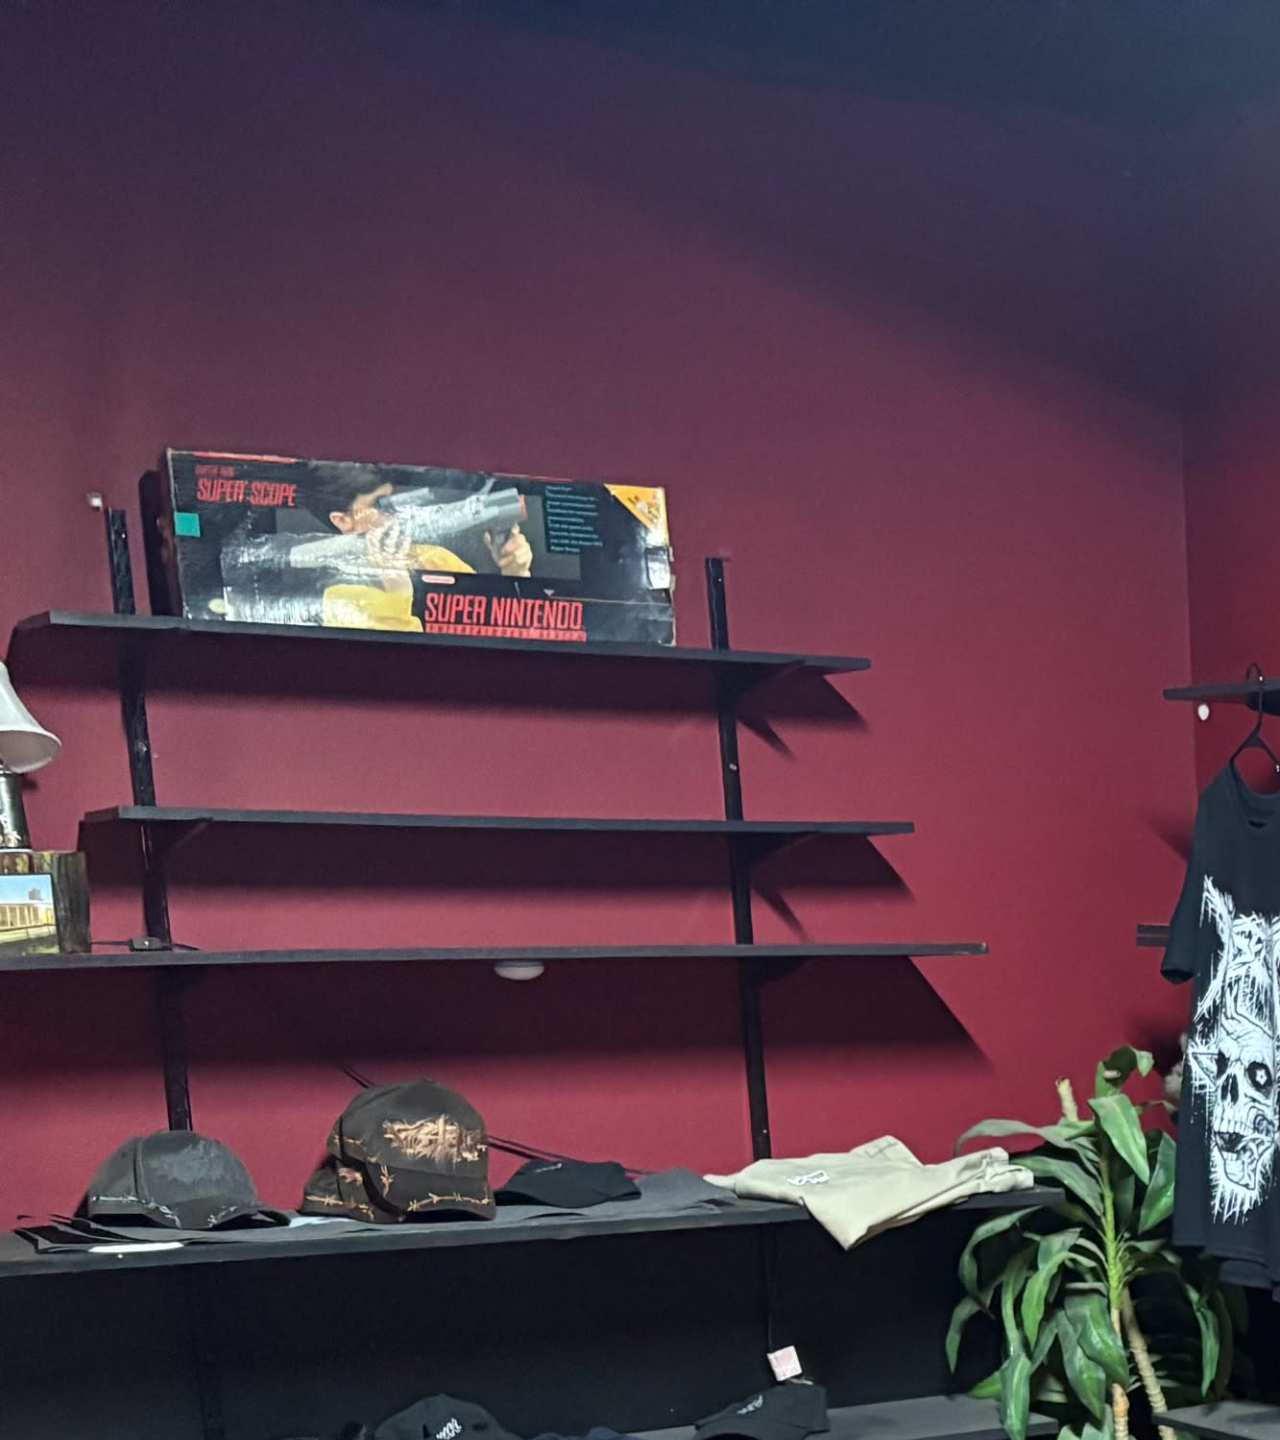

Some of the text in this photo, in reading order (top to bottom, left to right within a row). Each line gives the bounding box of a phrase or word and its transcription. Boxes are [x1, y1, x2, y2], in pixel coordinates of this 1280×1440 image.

[196, 478, 297, 507] SUPER SCOPE
[425, 592, 584, 630] SUPER NINTENDO
